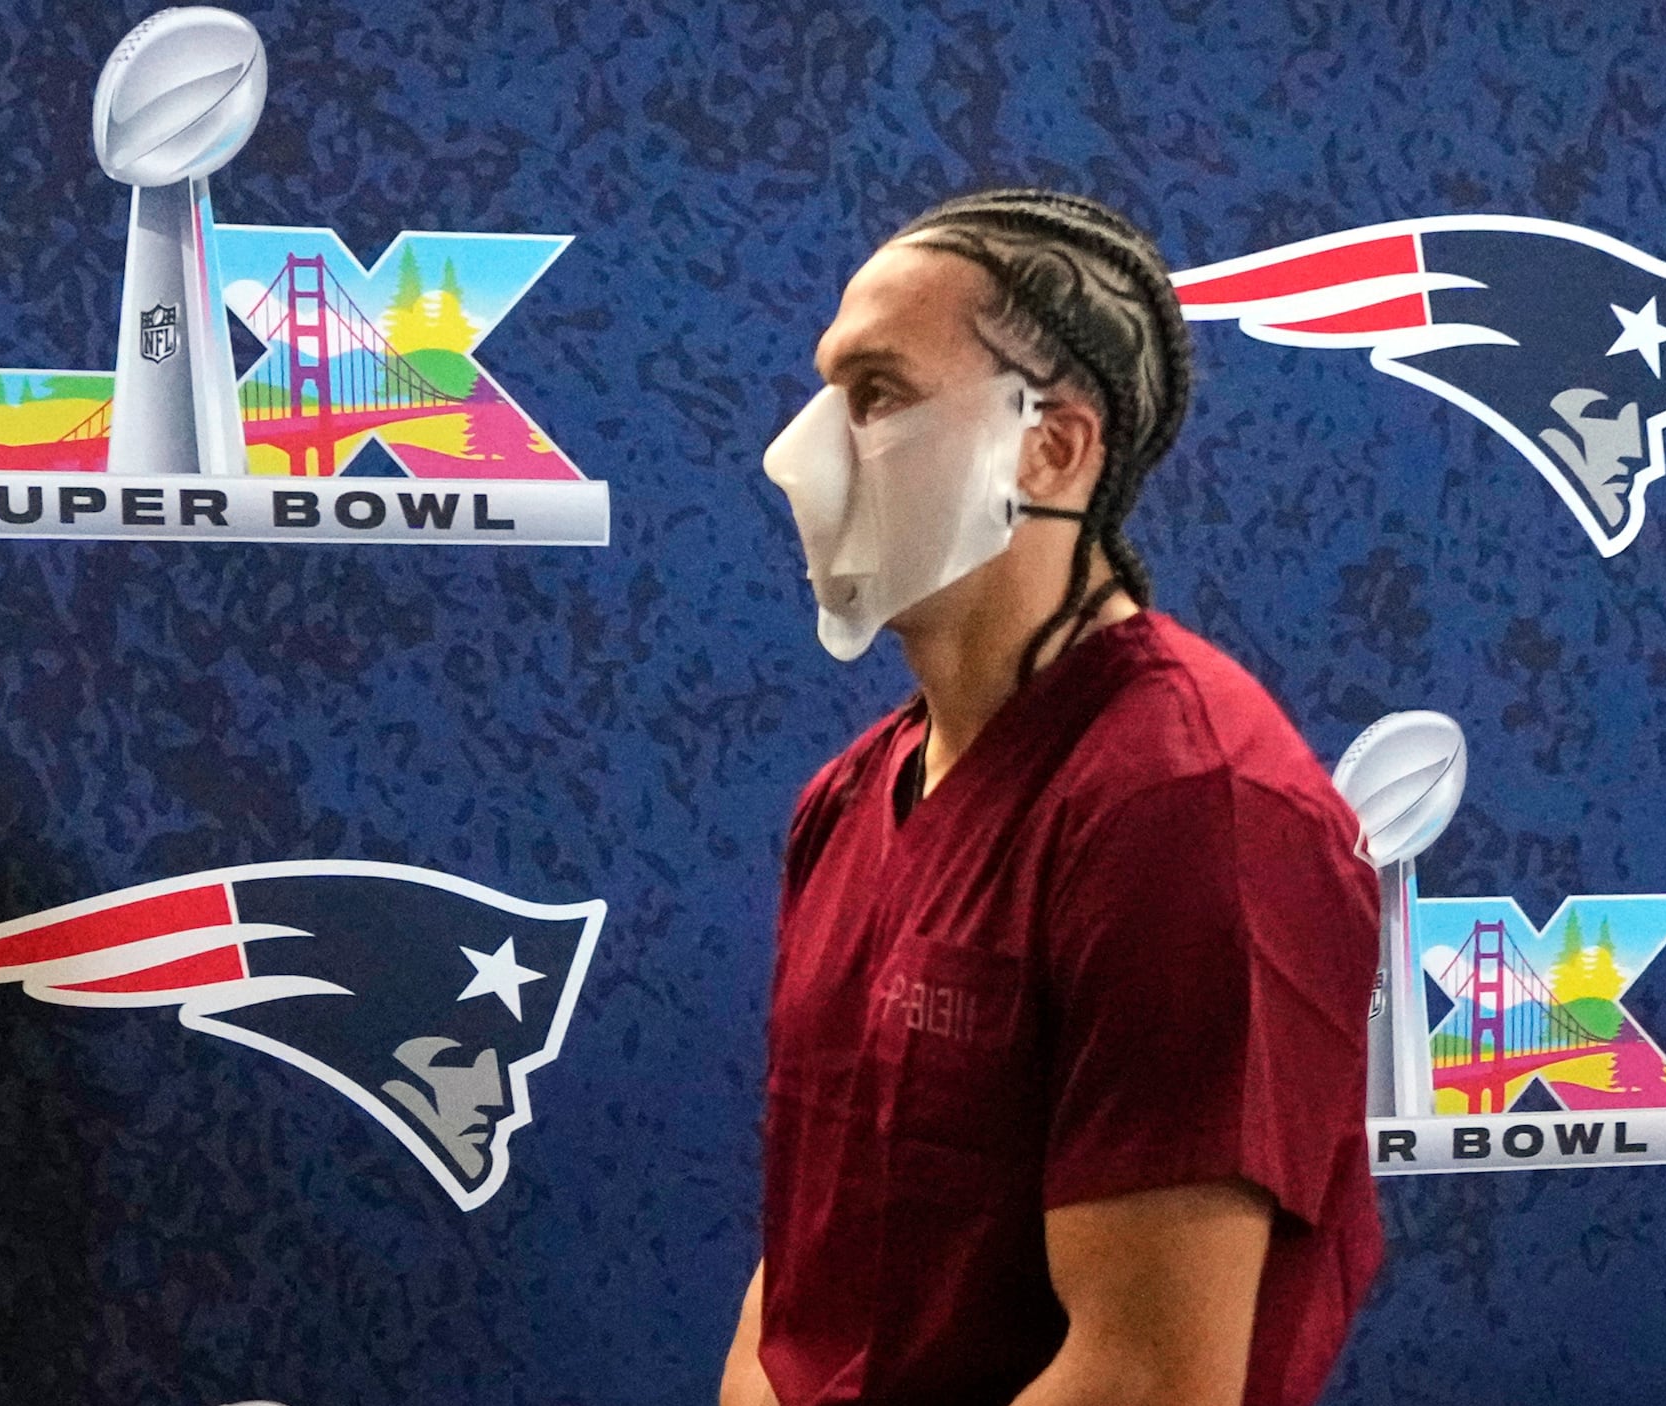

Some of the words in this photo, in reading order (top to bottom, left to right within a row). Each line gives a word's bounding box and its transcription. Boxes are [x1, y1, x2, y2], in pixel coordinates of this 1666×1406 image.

[143, 327, 174, 357] NFL
[272, 490, 516, 531] BOWL
[1452, 1121, 1648, 1160] BOWL
